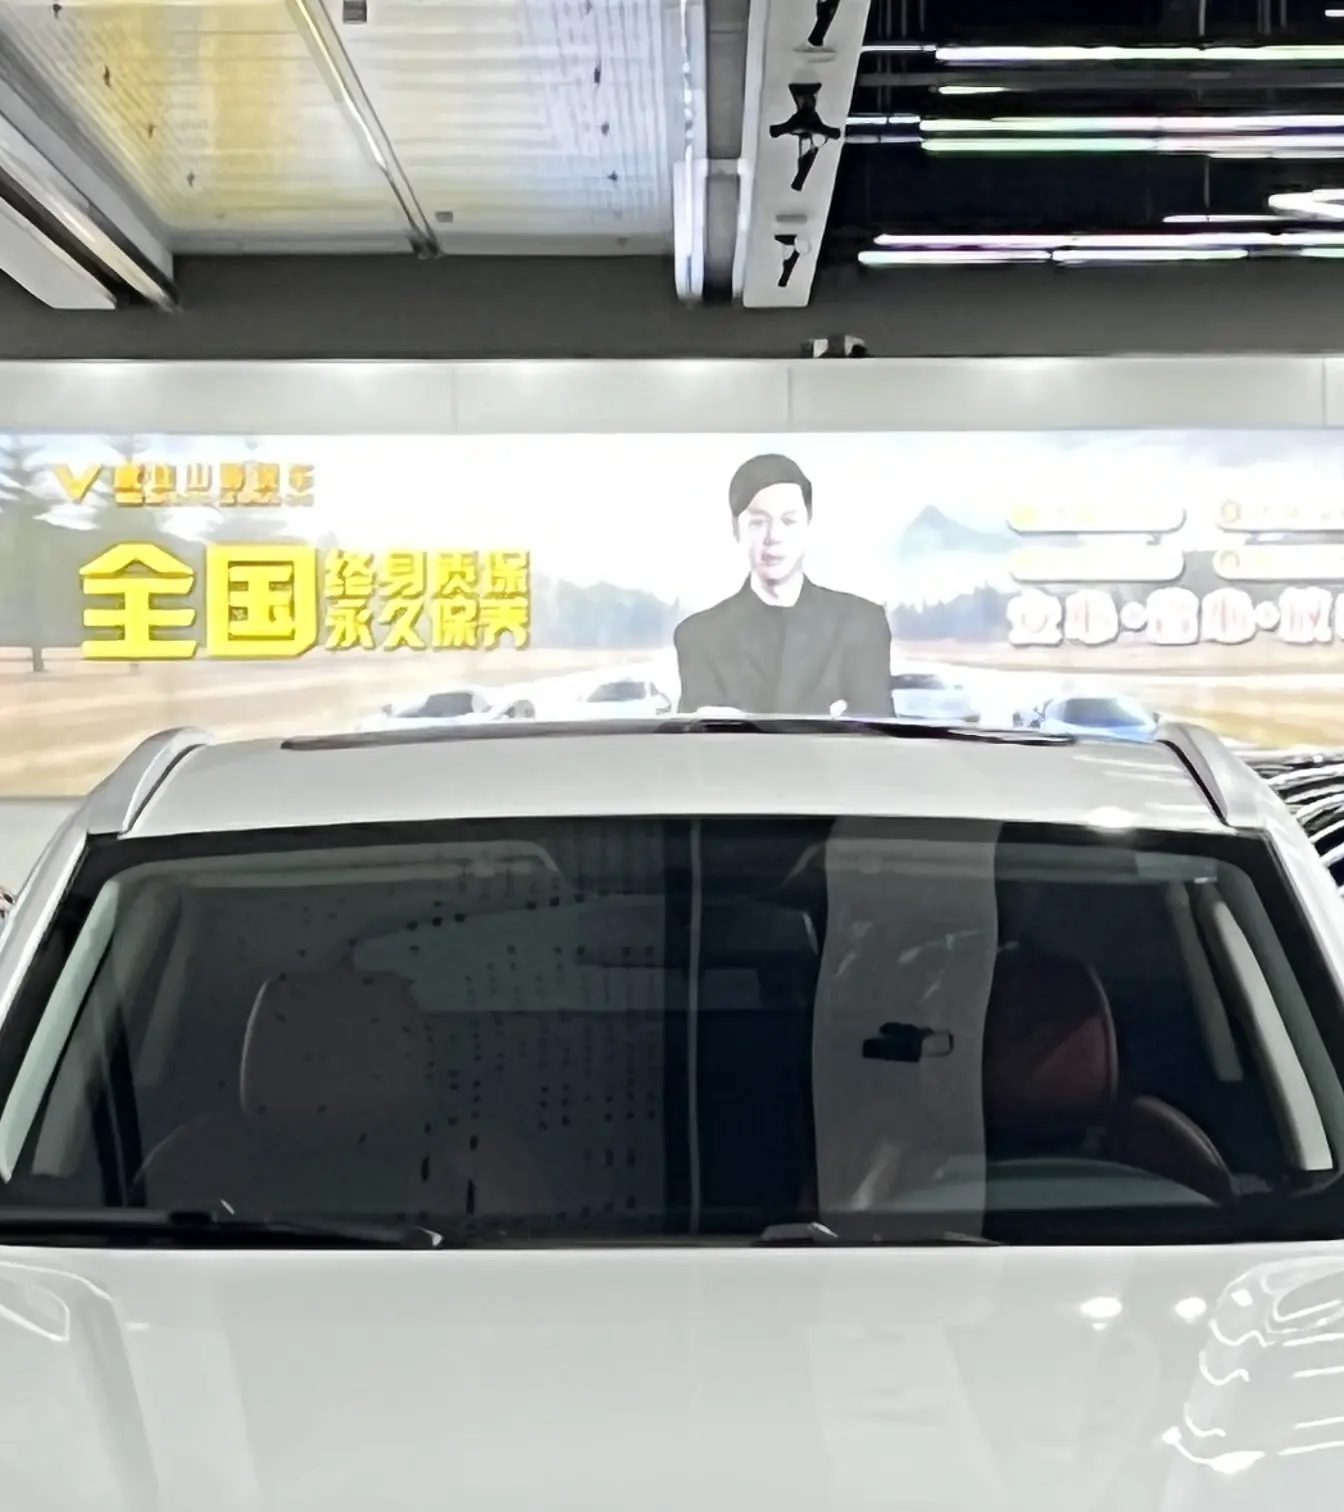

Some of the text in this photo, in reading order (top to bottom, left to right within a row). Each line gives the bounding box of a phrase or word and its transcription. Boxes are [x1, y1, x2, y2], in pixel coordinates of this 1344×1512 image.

[324, 549, 529, 600] 终身质保
[79, 542, 318, 661] 全国
[324, 599, 529, 651] 永久保养
